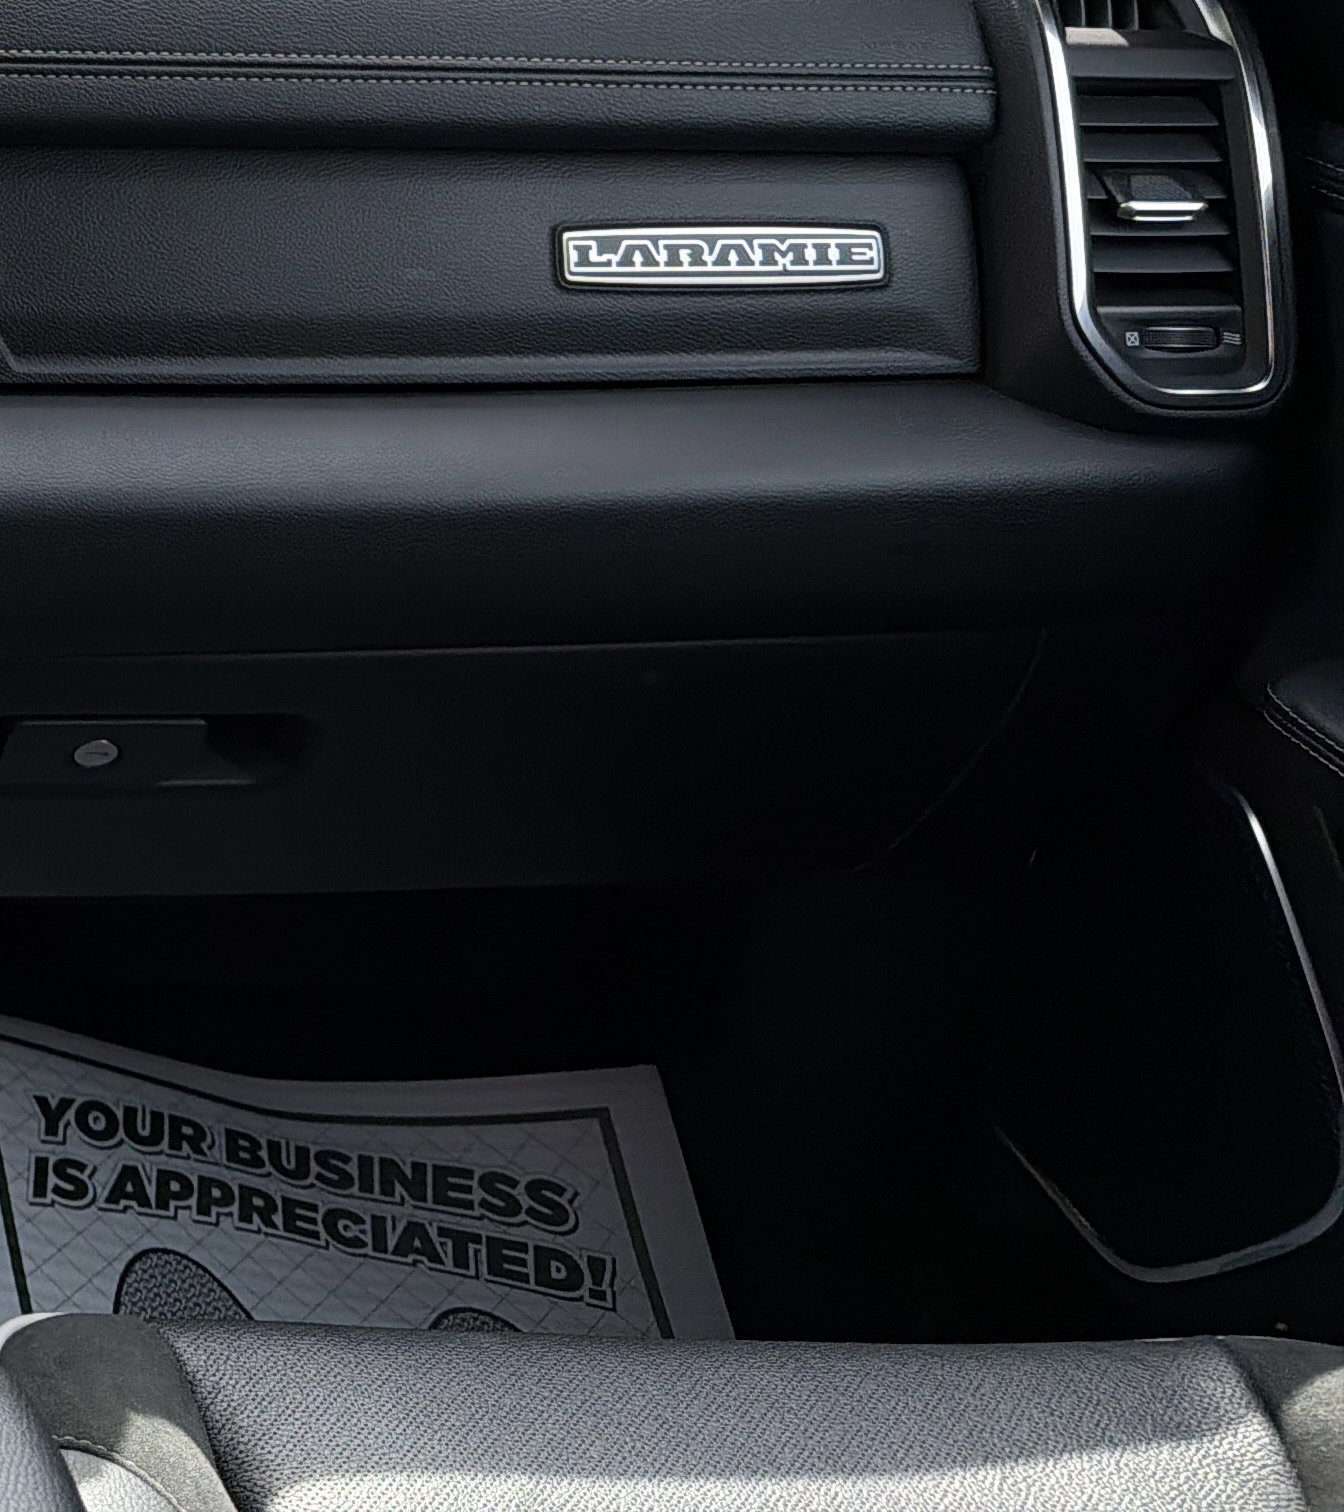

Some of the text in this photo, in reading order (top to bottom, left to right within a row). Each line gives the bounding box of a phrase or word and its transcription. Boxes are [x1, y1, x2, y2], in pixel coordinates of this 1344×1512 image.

[571, 239, 875, 269] LARAMIE
[33, 1094, 576, 1227] YOUR BUSINESS
[33, 1155, 616, 1304] IS APPRECIATED!
